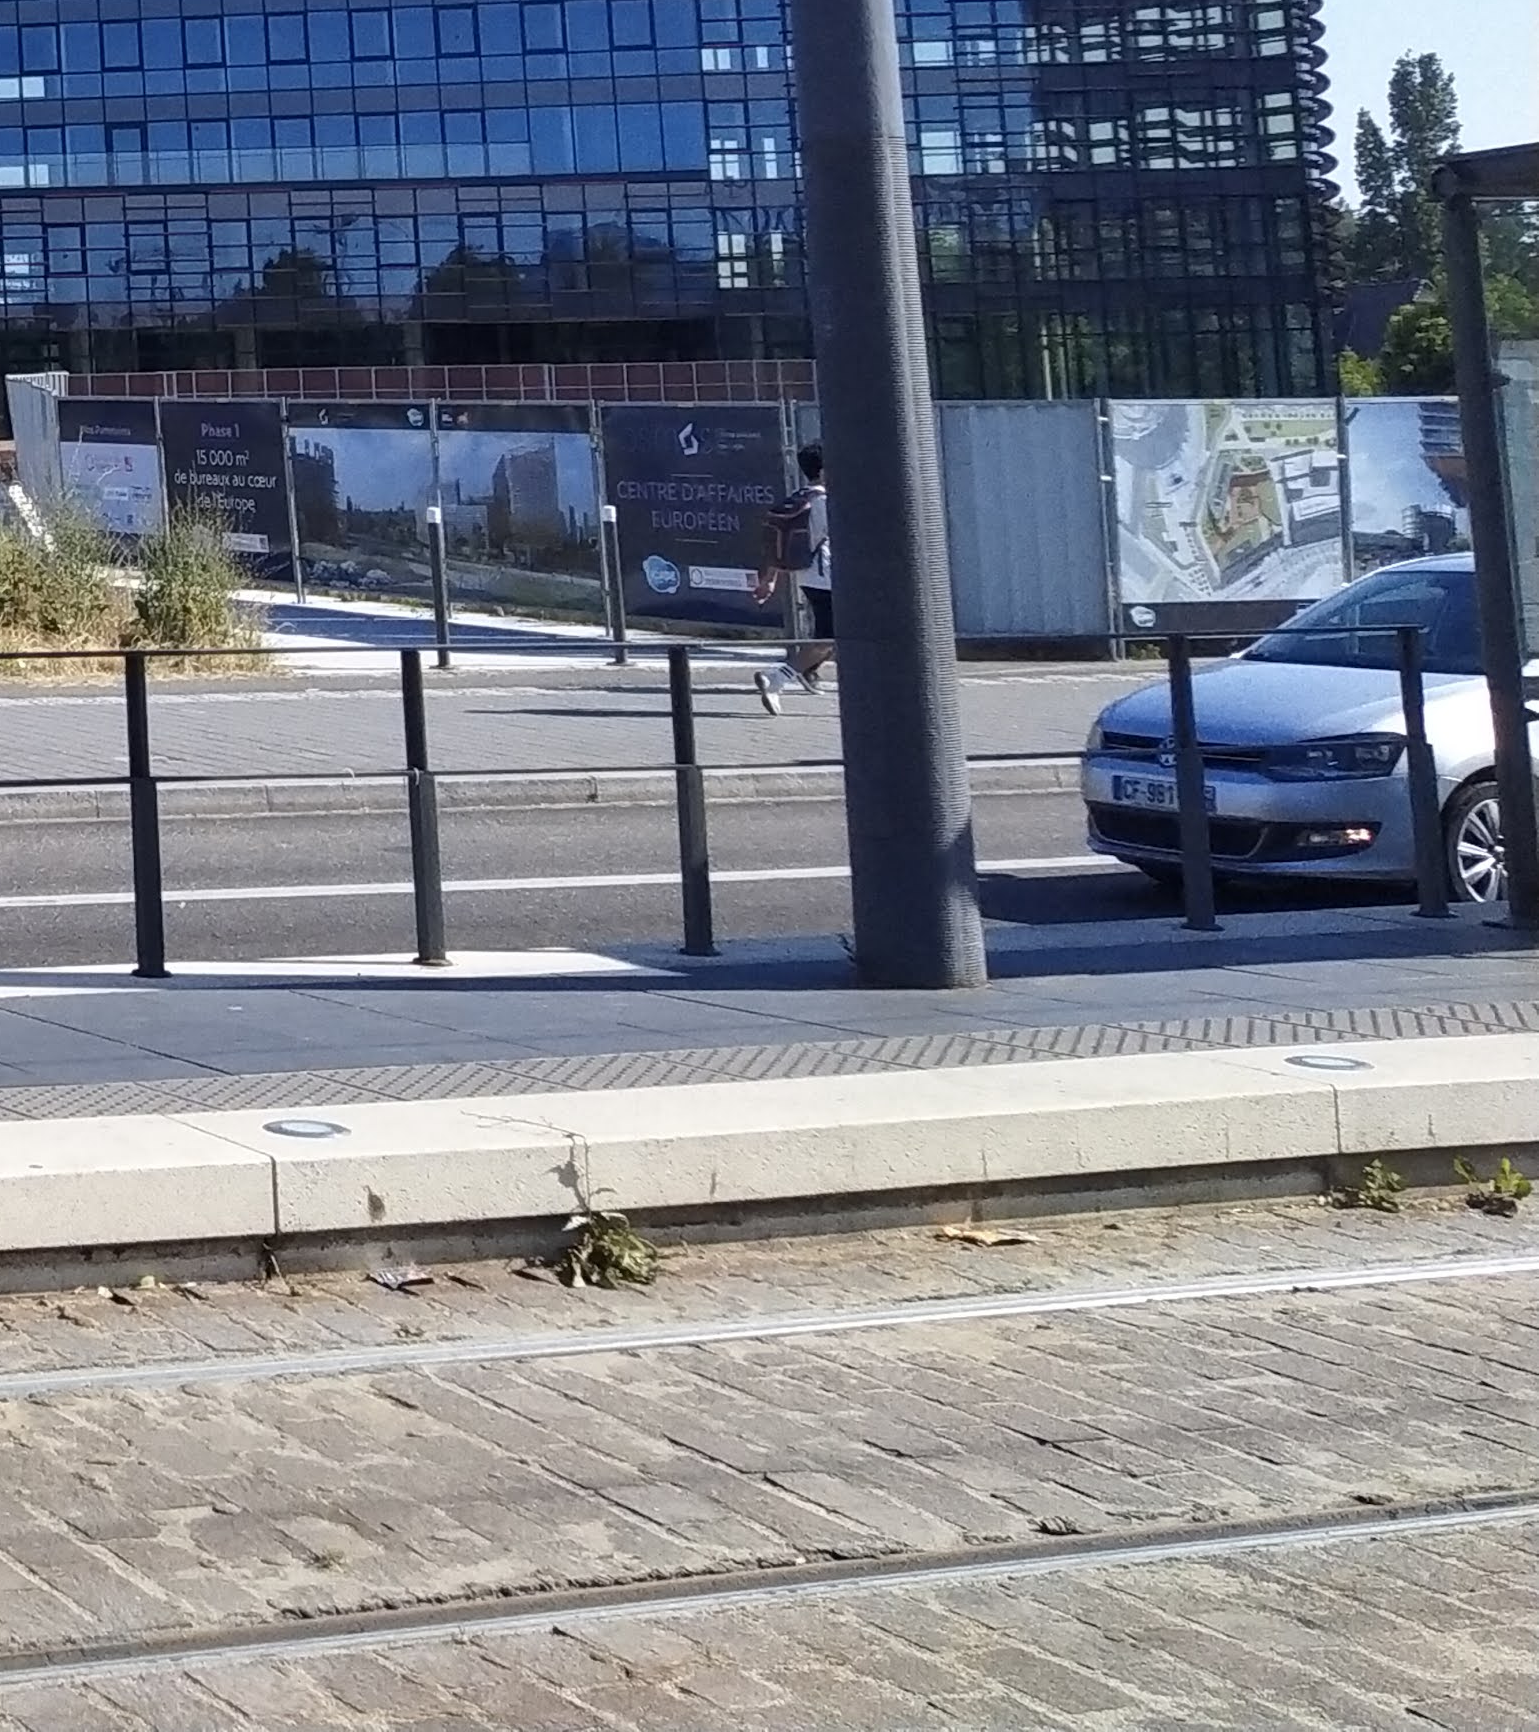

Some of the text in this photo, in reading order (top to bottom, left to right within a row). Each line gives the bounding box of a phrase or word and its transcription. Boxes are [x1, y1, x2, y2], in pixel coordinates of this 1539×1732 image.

[201, 422, 240, 438] Phase 1
[196, 449, 207, 466] 15
[209, 450, 234, 466] 000
[174, 468, 277, 488] de bureaux au cœur
[198, 491, 211, 508] de
[617, 481, 774, 504] CENTRE D'AFFAIRES
[652, 510, 740, 532] EUROPÉEN
